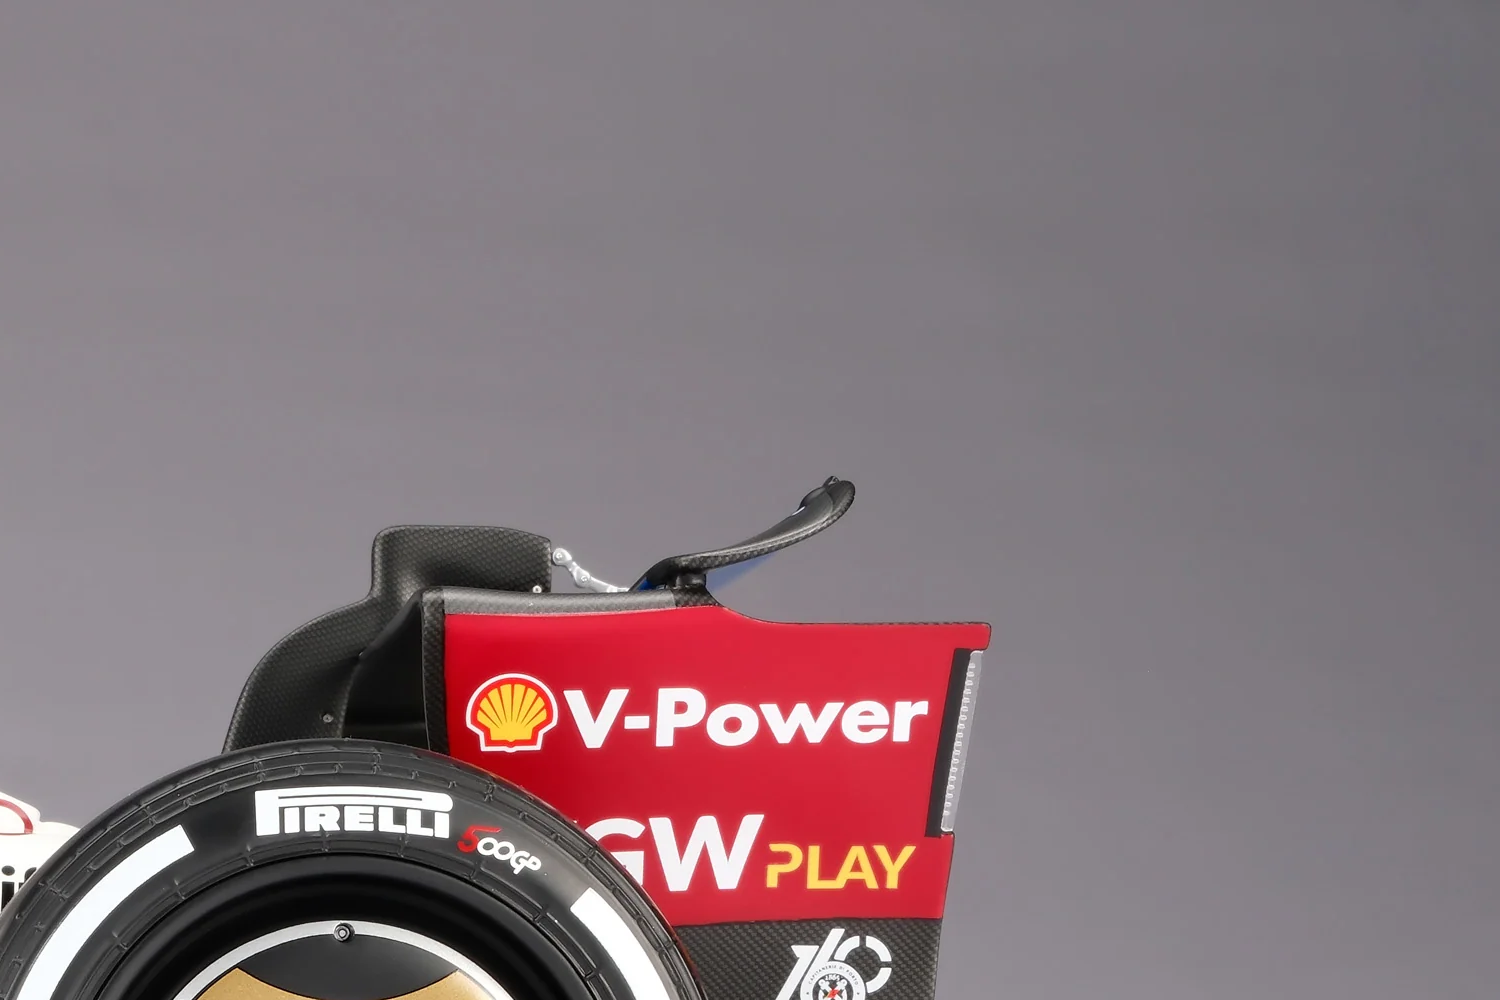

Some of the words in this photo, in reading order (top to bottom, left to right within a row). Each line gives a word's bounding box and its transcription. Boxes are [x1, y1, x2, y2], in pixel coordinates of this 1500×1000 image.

[564, 687, 928, 749] V-Power
[255, 786, 453, 839] PIRELLI
[457, 825, 542, 874] 500GP
[766, 843, 916, 889] PLAY
